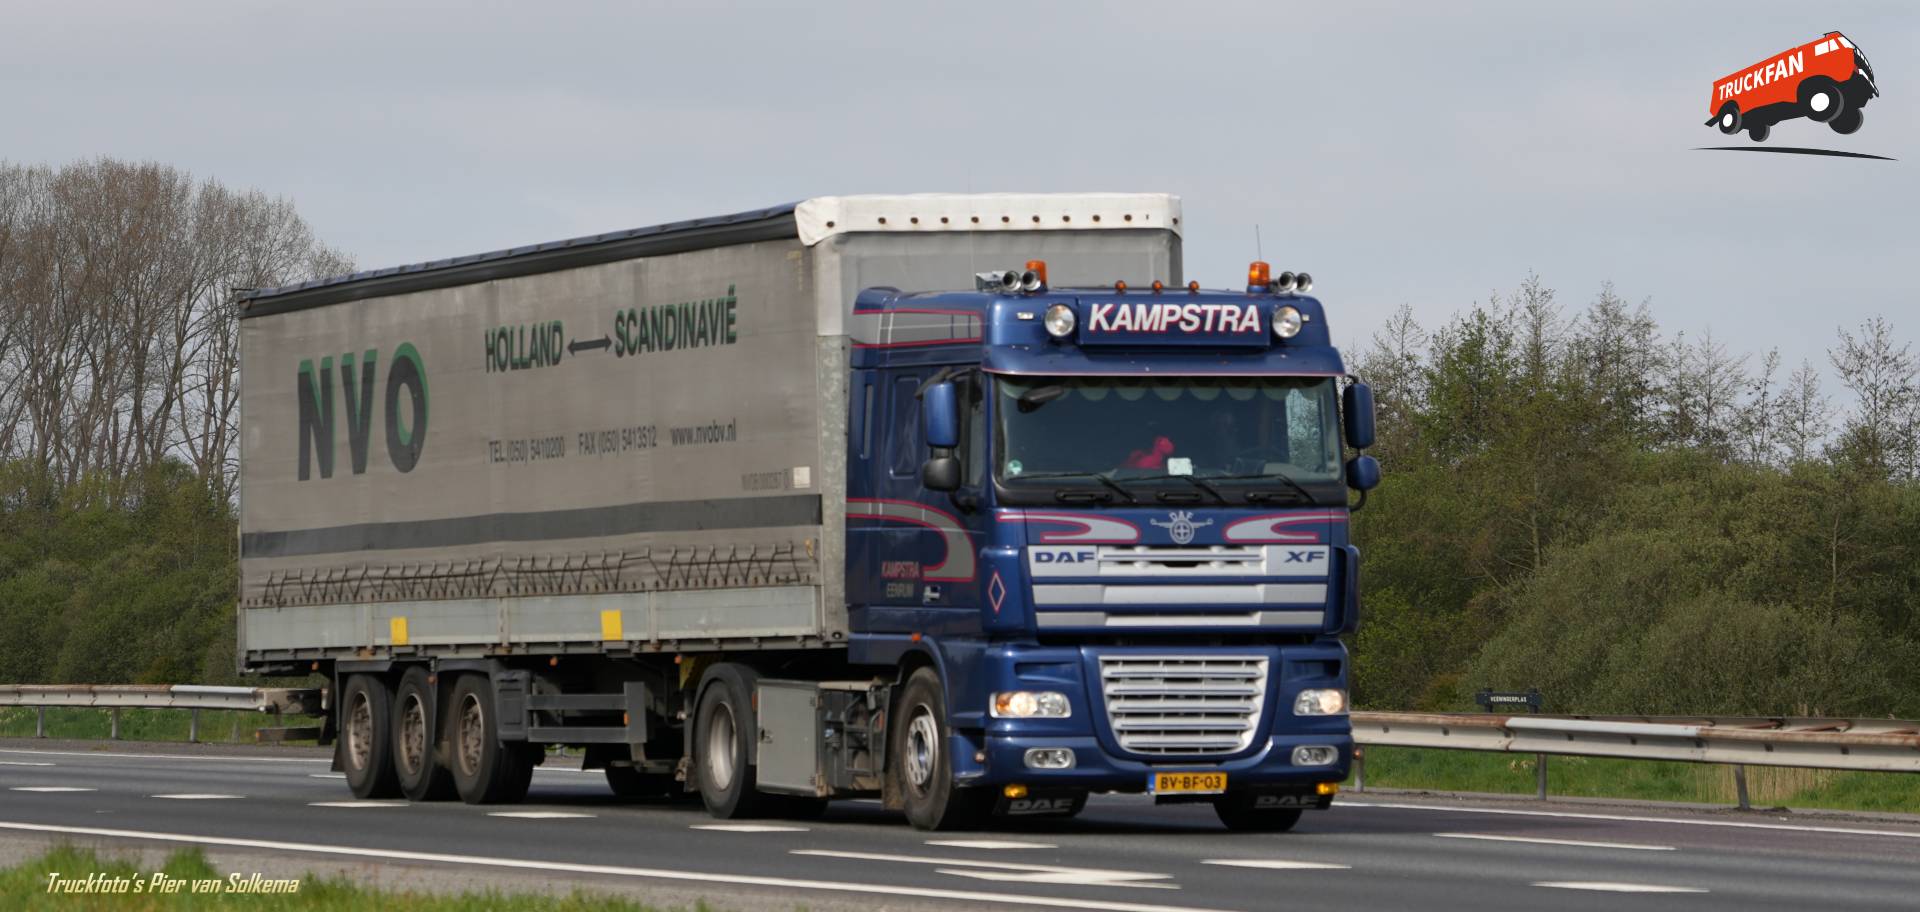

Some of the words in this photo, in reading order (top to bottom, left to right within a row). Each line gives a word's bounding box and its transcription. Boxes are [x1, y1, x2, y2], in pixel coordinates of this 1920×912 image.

[1088, 303, 1262, 333] KAMPSTRA
[484, 320, 563, 373] HOLLAND
[615, 284, 737, 358] SCANDINAVIË
[297, 341, 430, 482] NVO
[578, 431, 597, 455] FAX
[1169, 511, 1193, 521] DAF
[1035, 551, 1096, 563] DAF
[1284, 551, 1325, 563] XF
[1160, 775, 1222, 790] BV-BF-03
[1009, 799, 1073, 811] DAF
